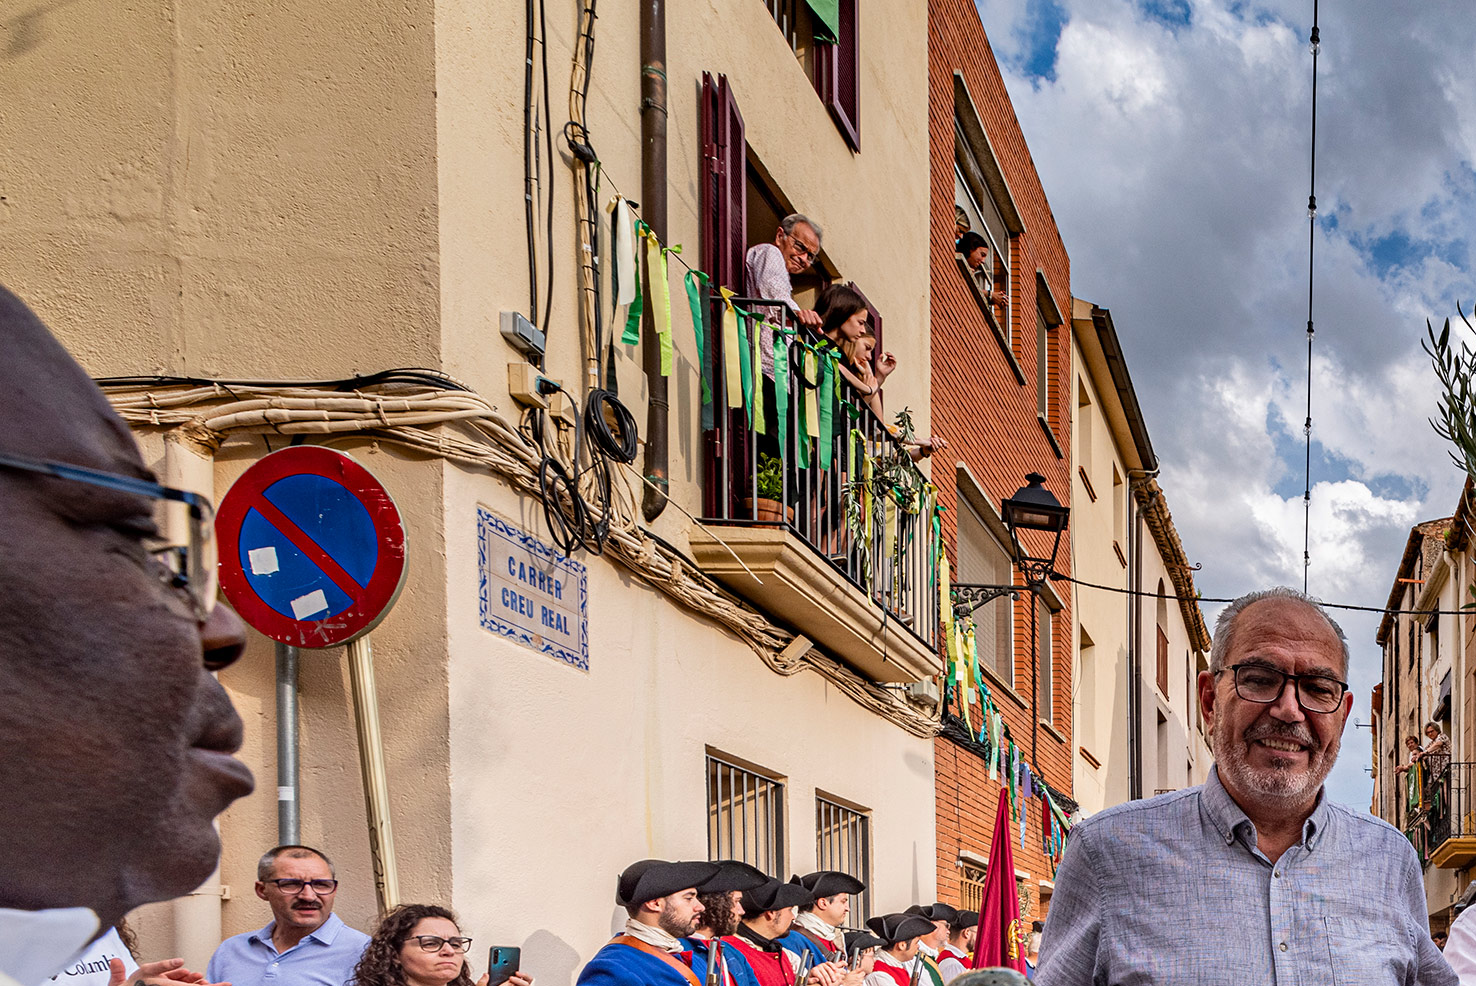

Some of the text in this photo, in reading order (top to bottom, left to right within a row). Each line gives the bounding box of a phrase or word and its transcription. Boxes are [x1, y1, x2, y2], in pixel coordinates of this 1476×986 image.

[508, 556, 562, 600] CARRER
[501, 587, 570, 636] CREU REAL
